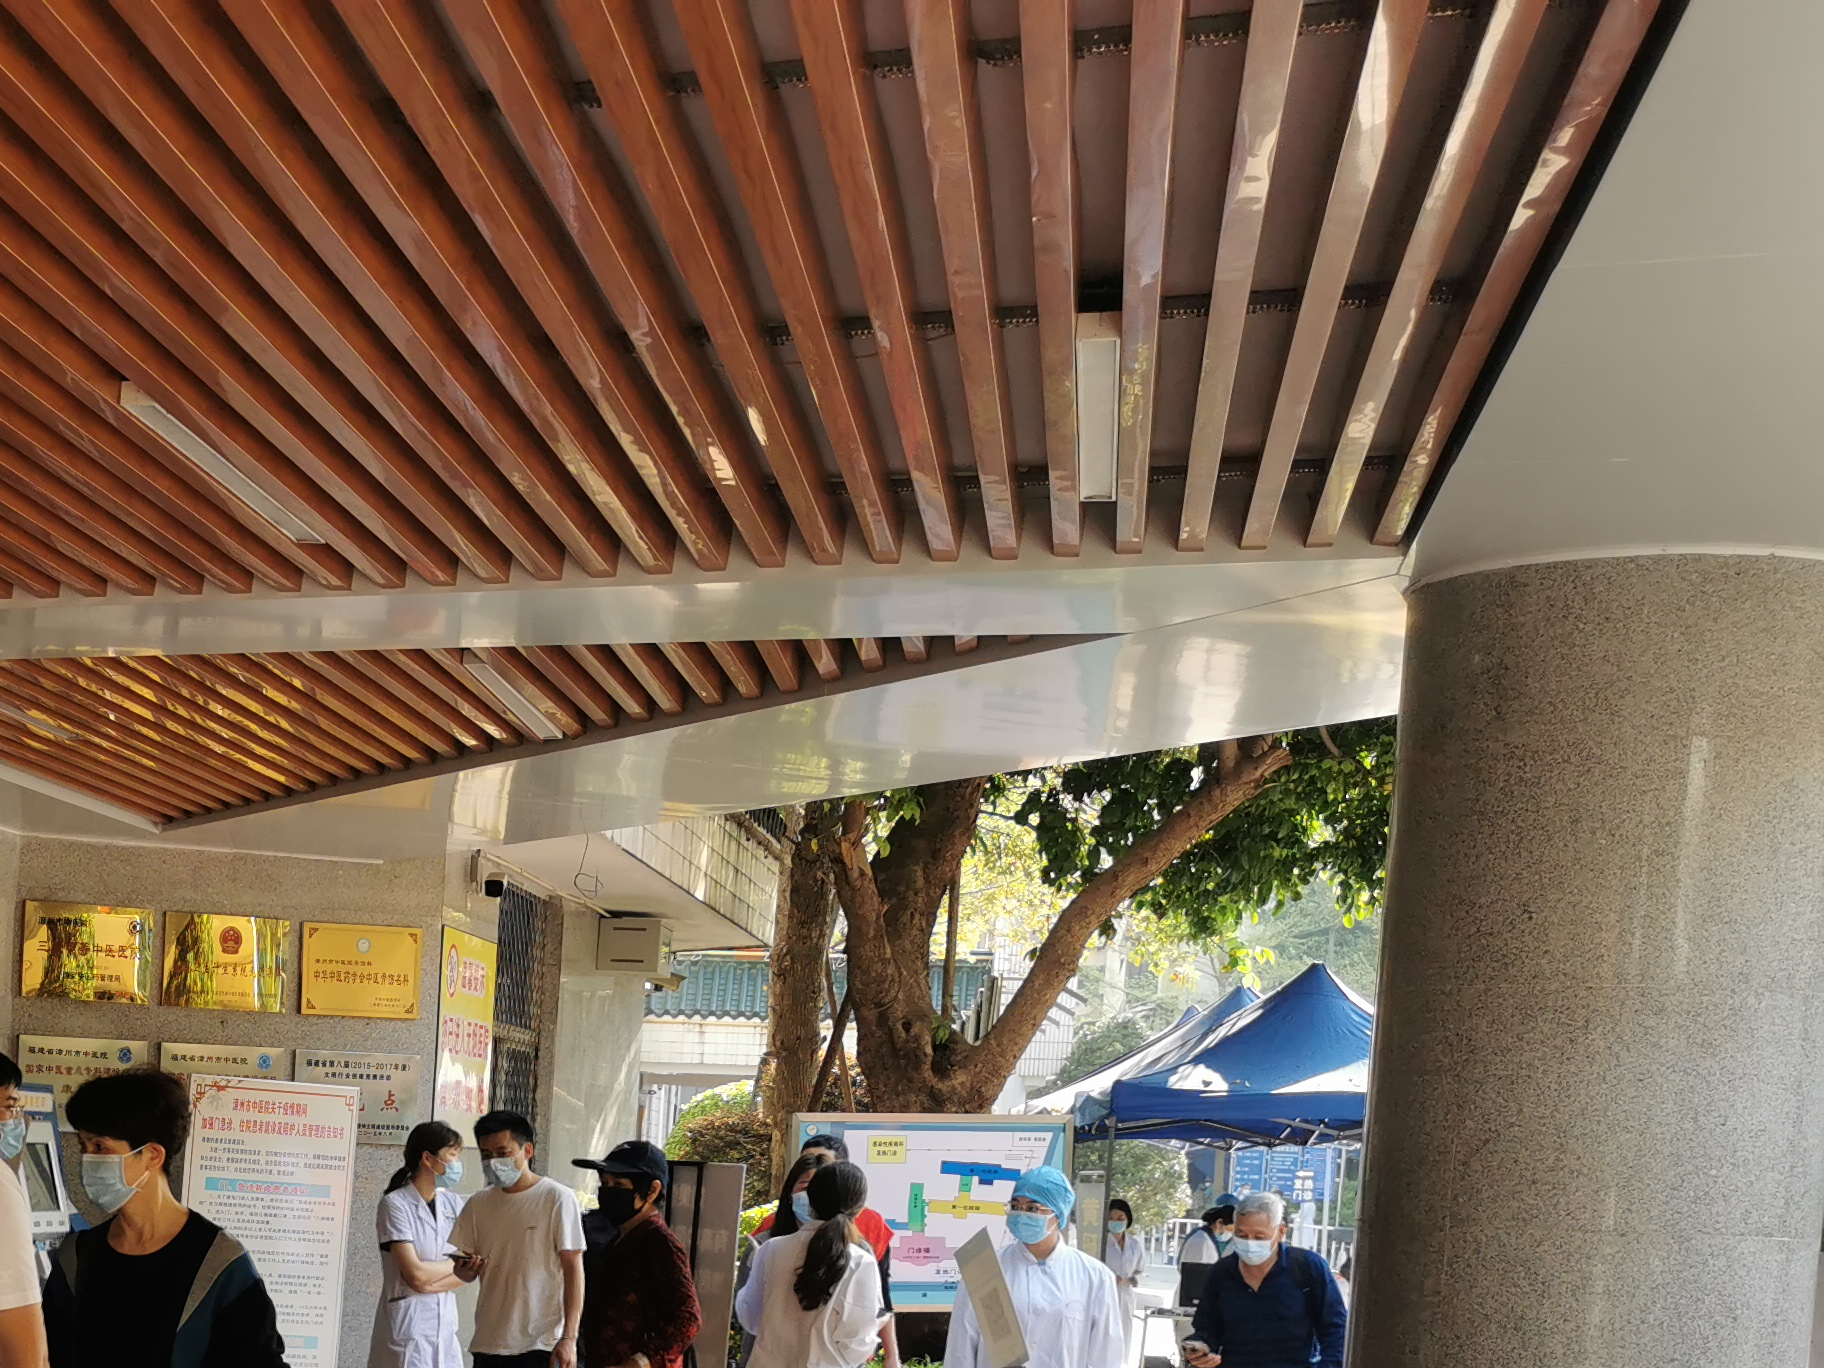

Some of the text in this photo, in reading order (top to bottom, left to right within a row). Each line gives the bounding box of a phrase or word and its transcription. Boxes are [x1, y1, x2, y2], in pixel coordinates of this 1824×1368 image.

[313, 968, 410, 987] 中华中医药学会中医骨伤名科
[169, 1053, 249, 1066] 福建省漳州市中医院
[232, 1097, 308, 1118] 漳州市中医院关于疫情期间
